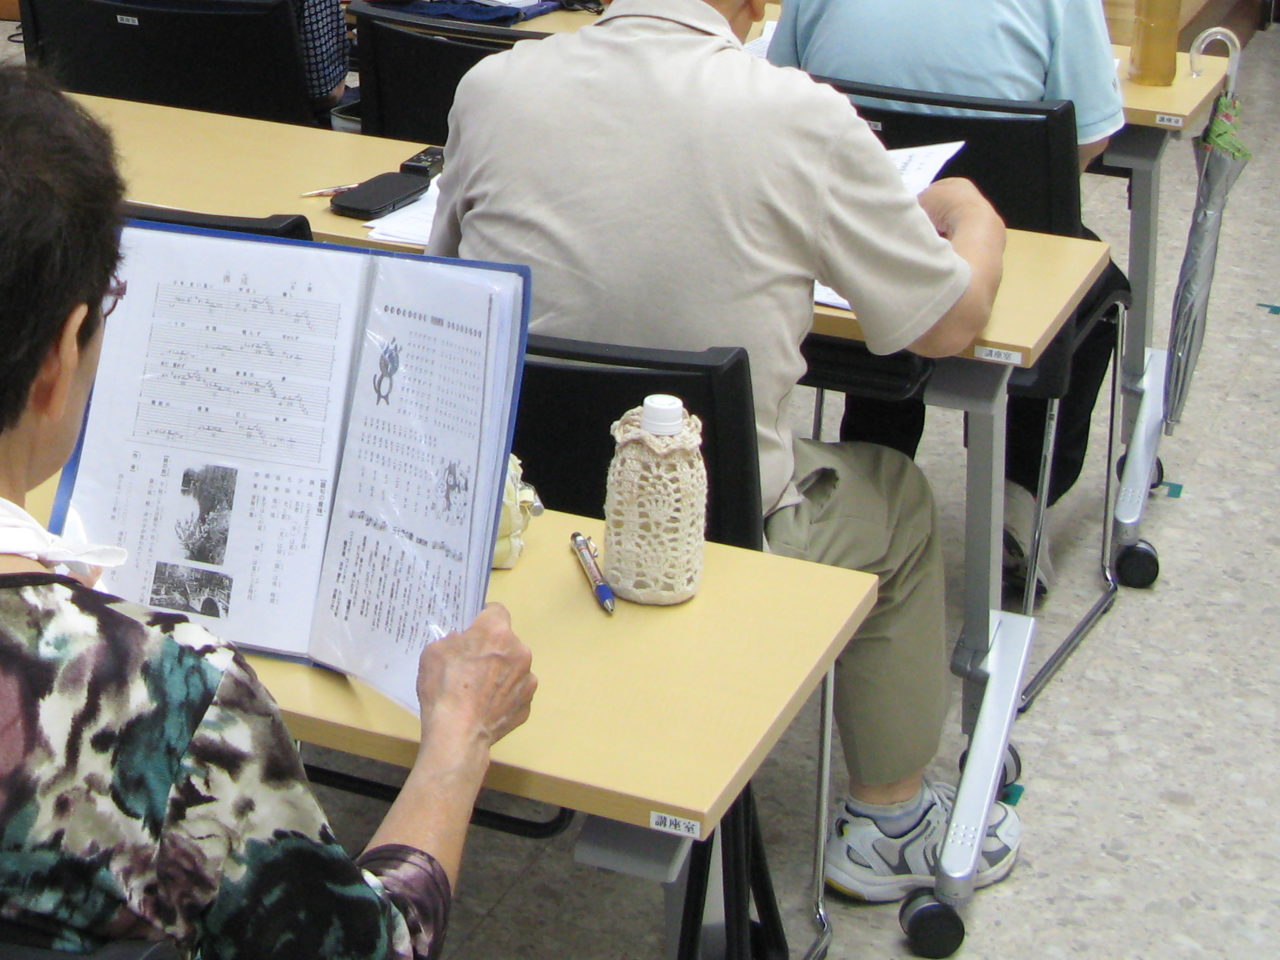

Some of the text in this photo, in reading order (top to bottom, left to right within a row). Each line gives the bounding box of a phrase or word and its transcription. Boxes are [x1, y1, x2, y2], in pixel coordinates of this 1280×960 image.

[985, 349, 1012, 361] 講座室
[655, 814, 696, 834] 講座室
